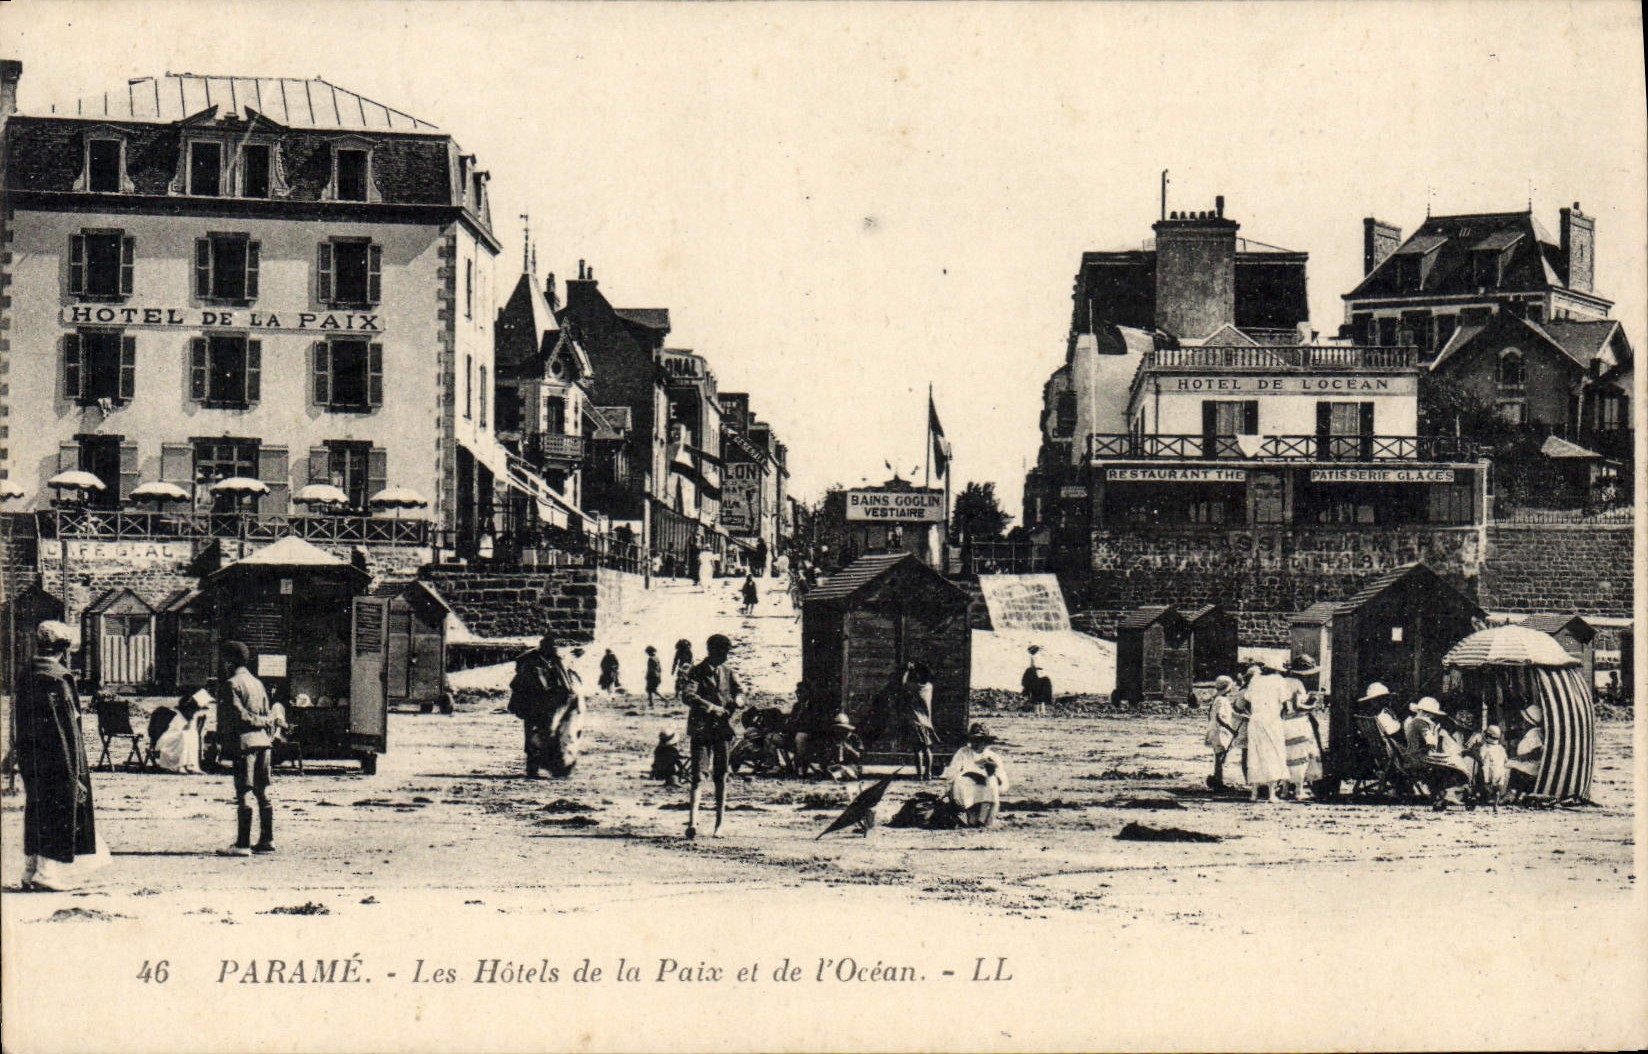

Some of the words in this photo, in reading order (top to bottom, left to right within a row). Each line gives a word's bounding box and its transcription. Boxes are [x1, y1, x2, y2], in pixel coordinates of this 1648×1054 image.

[71, 306, 184, 325] HOTEL
[201, 311, 233, 326] DE
[249, 313, 282, 328] LA
[299, 313, 379, 331] PAIX
[1177, 378, 1242, 391] HOTEL
[1258, 379, 1284, 391] DE
[1108, 470, 1209, 480] RESTAURANT
[1216, 470, 1244, 480] THE
[1311, 470, 1391, 480] PATISSERIE
[1397, 471, 1454, 480] GLACES
[851, 494, 890, 506] BAINS
[895, 495, 940, 507] GOGLIN
[864, 506, 926, 518] VESTIAIRE
